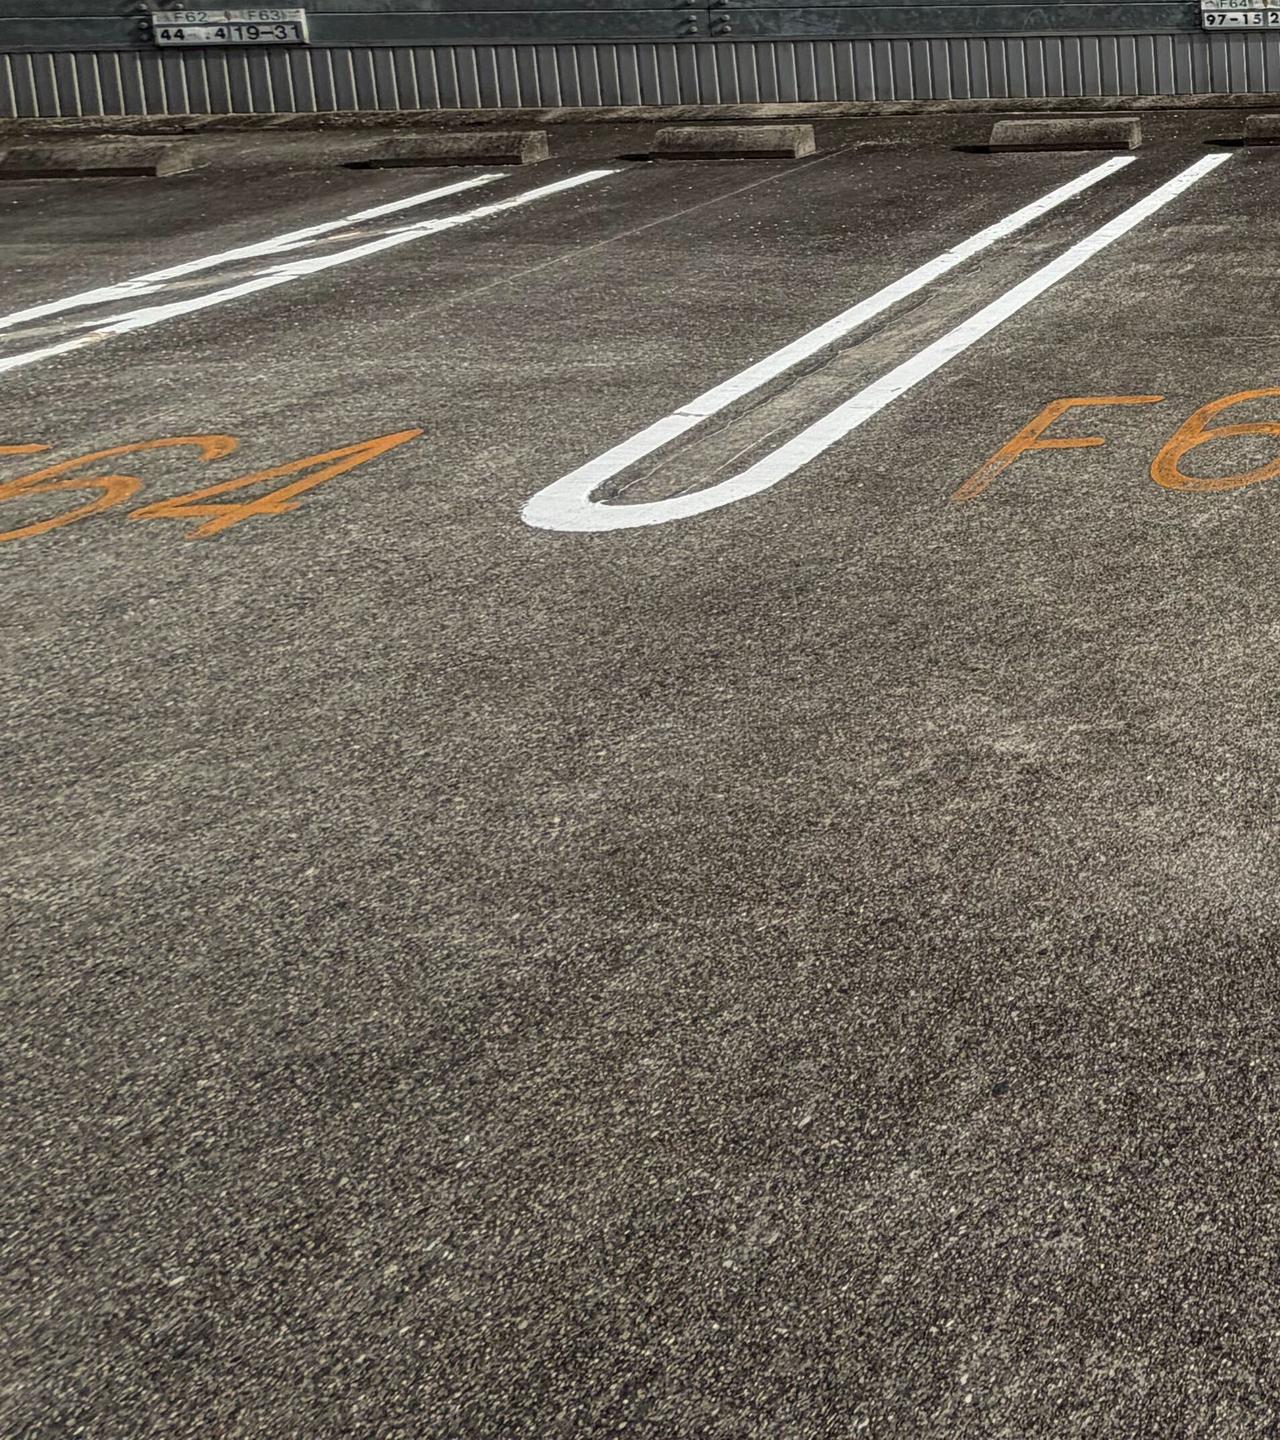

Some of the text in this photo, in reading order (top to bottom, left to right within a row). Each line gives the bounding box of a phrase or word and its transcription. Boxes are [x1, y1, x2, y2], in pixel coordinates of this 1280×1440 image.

[174, 10, 281, 23] F62 F63
[1206, 14, 1262, 25] 97-15
[234, 25, 300, 41] 19-31
